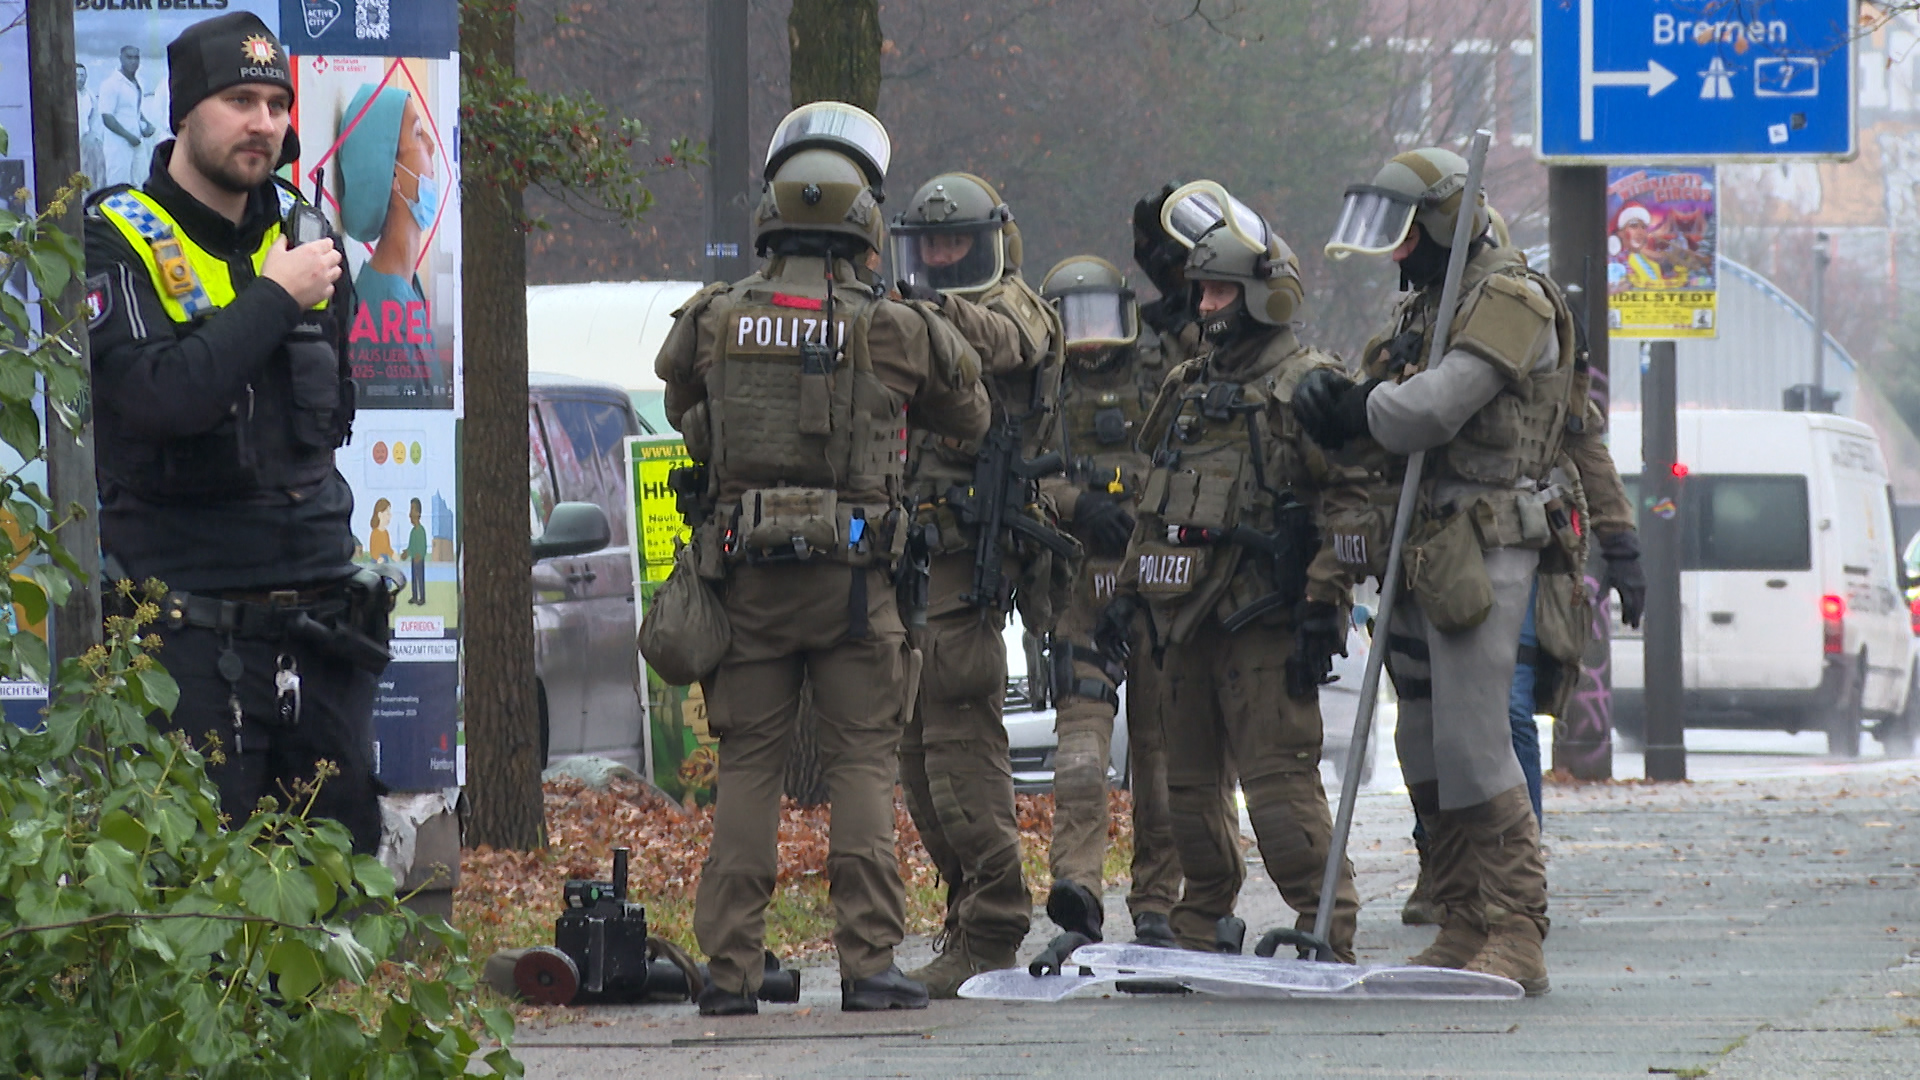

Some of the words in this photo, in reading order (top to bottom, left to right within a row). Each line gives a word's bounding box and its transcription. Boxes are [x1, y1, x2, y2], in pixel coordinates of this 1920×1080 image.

[307, 10, 334, 18] ACTIVE
[1653, 13, 1788, 44] Bremen
[240, 67, 286, 80] POLIZEI
[1779, 65, 1794, 89] 7
[349, 299, 432, 344] ARE!
[358, 349, 380, 362] AUS
[1139, 555, 1191, 583] POLIZEI
